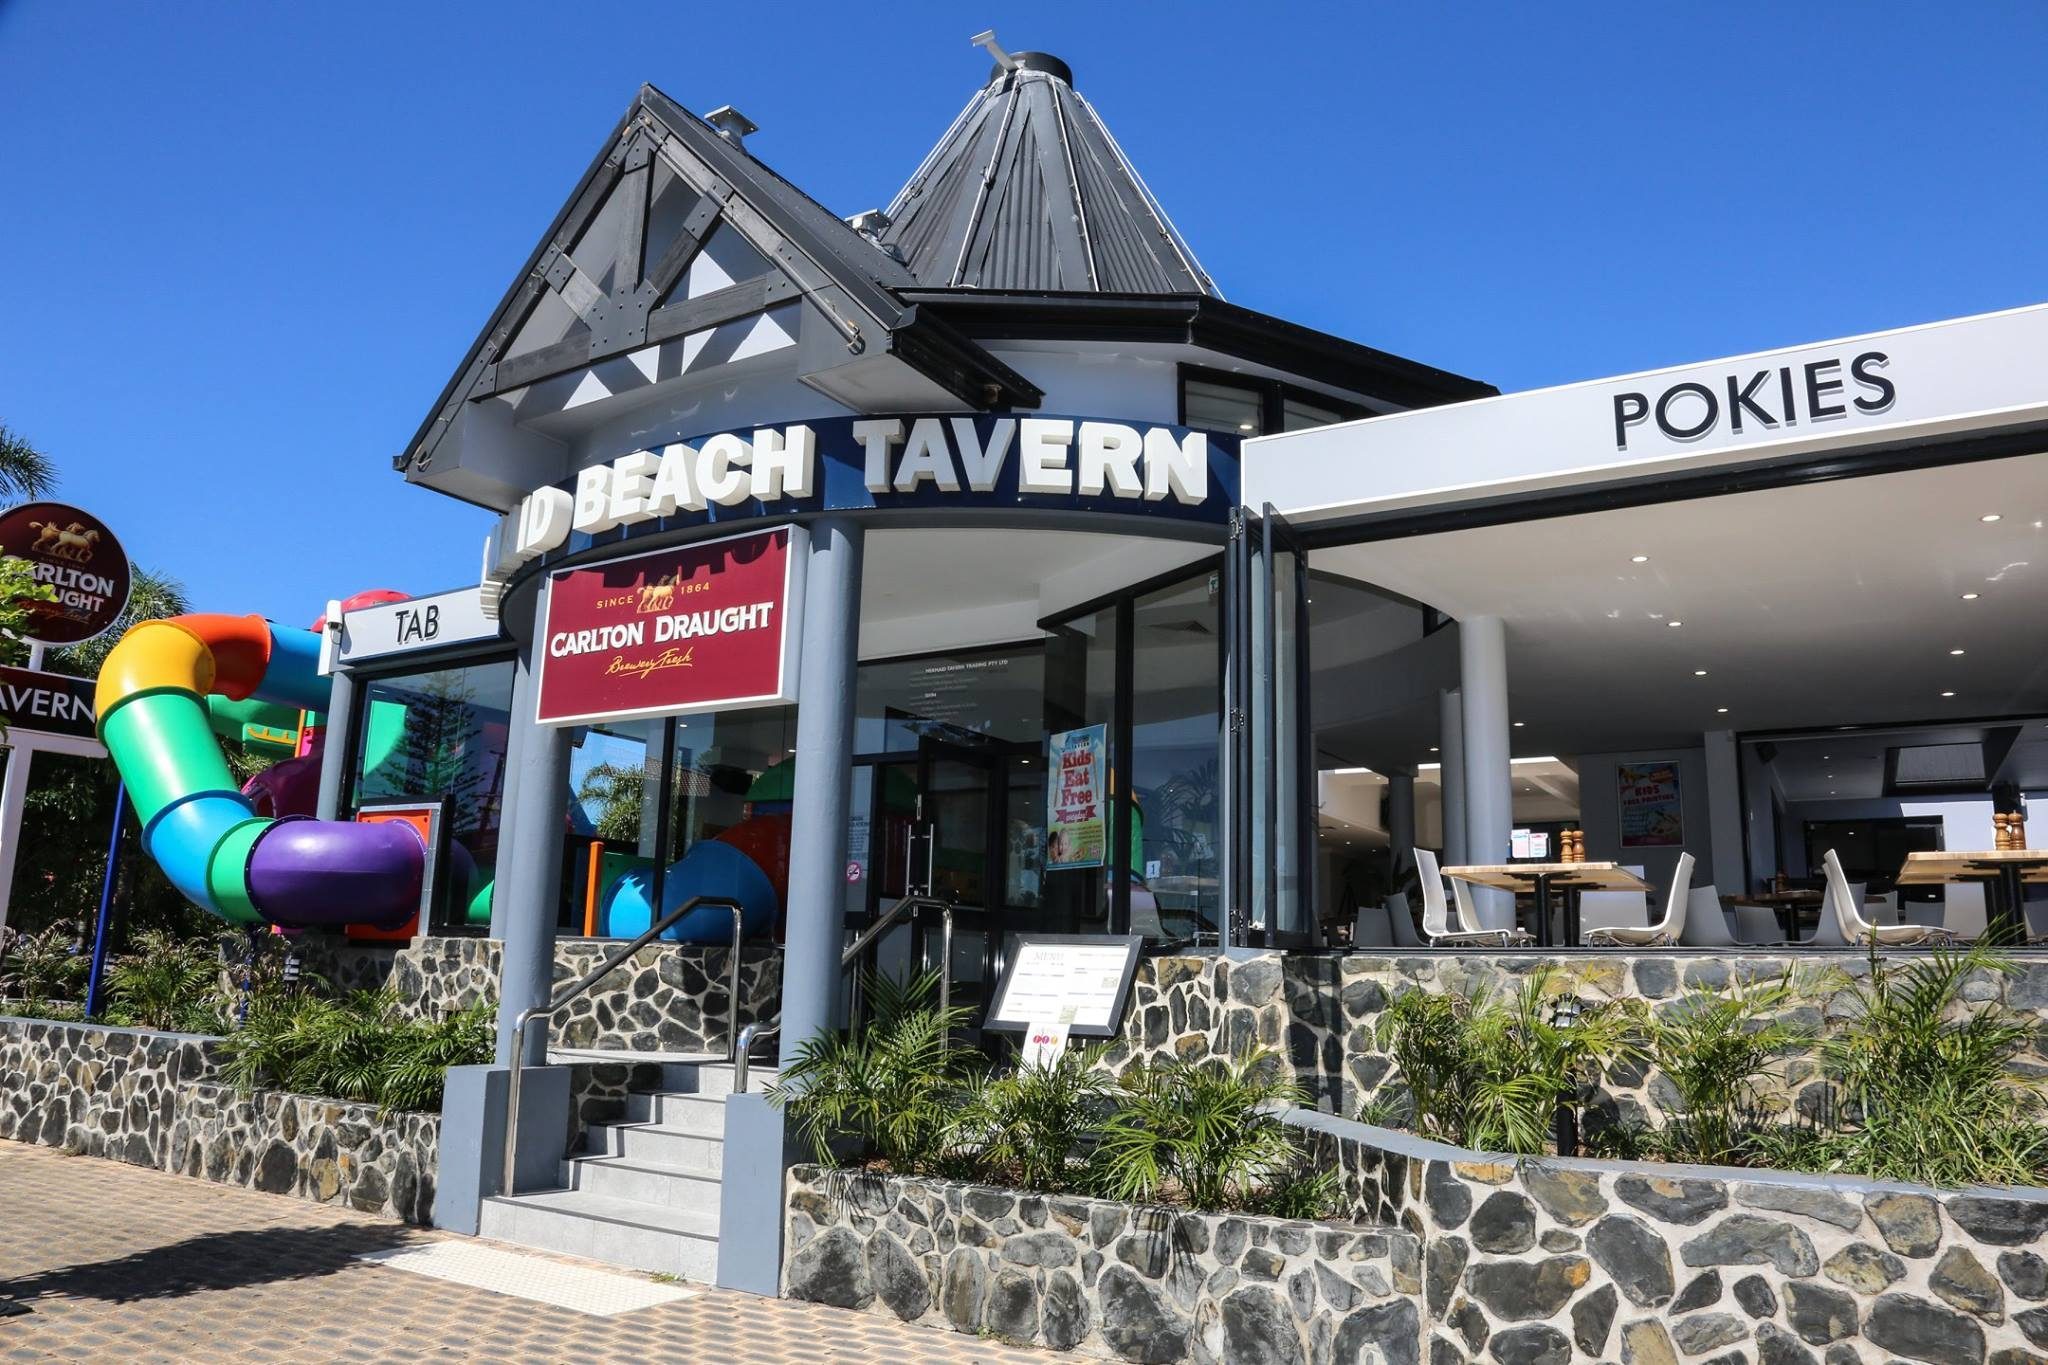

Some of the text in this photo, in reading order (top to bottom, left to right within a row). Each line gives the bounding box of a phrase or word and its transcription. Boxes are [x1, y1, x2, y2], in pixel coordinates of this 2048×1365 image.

[1613, 351, 1896, 451] POKIES
[572, 424, 816, 535] BEACH
[852, 418, 1208, 506] TAVERN
[596, 582, 710, 609] SINCE 1864
[395, 605, 440, 645] TAB
[550, 602, 774, 658] CARLTON DRAUGHT
[604, 646, 694, 679] Brewery Fresh
[966, 661, 987, 669] TRADING
[1062, 749, 1091, 769] Kids
[1064, 767, 1090, 788] Eat
[1635, 784, 1660, 796] KIDS
[1061, 788, 1092, 807] Free
